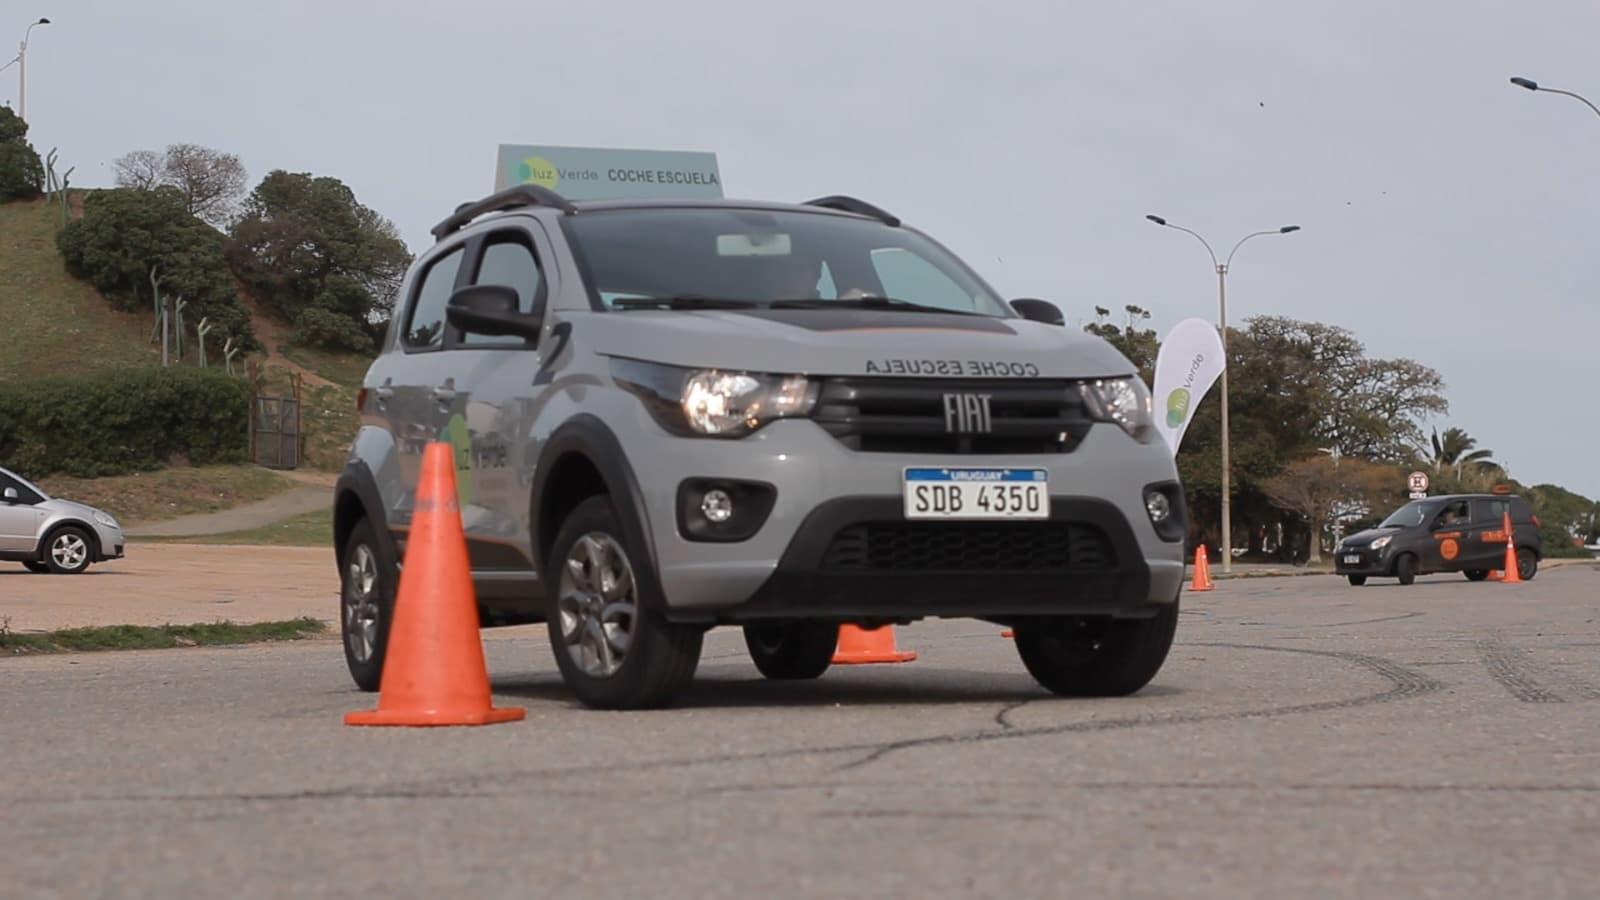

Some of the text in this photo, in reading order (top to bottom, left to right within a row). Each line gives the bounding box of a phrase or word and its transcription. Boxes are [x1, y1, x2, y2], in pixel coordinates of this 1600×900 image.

[532, 167, 719, 185] luz Verde COCHE ESCUELA
[943, 393, 992, 433] FIAT
[915, 485, 1039, 512] SDB 4350
